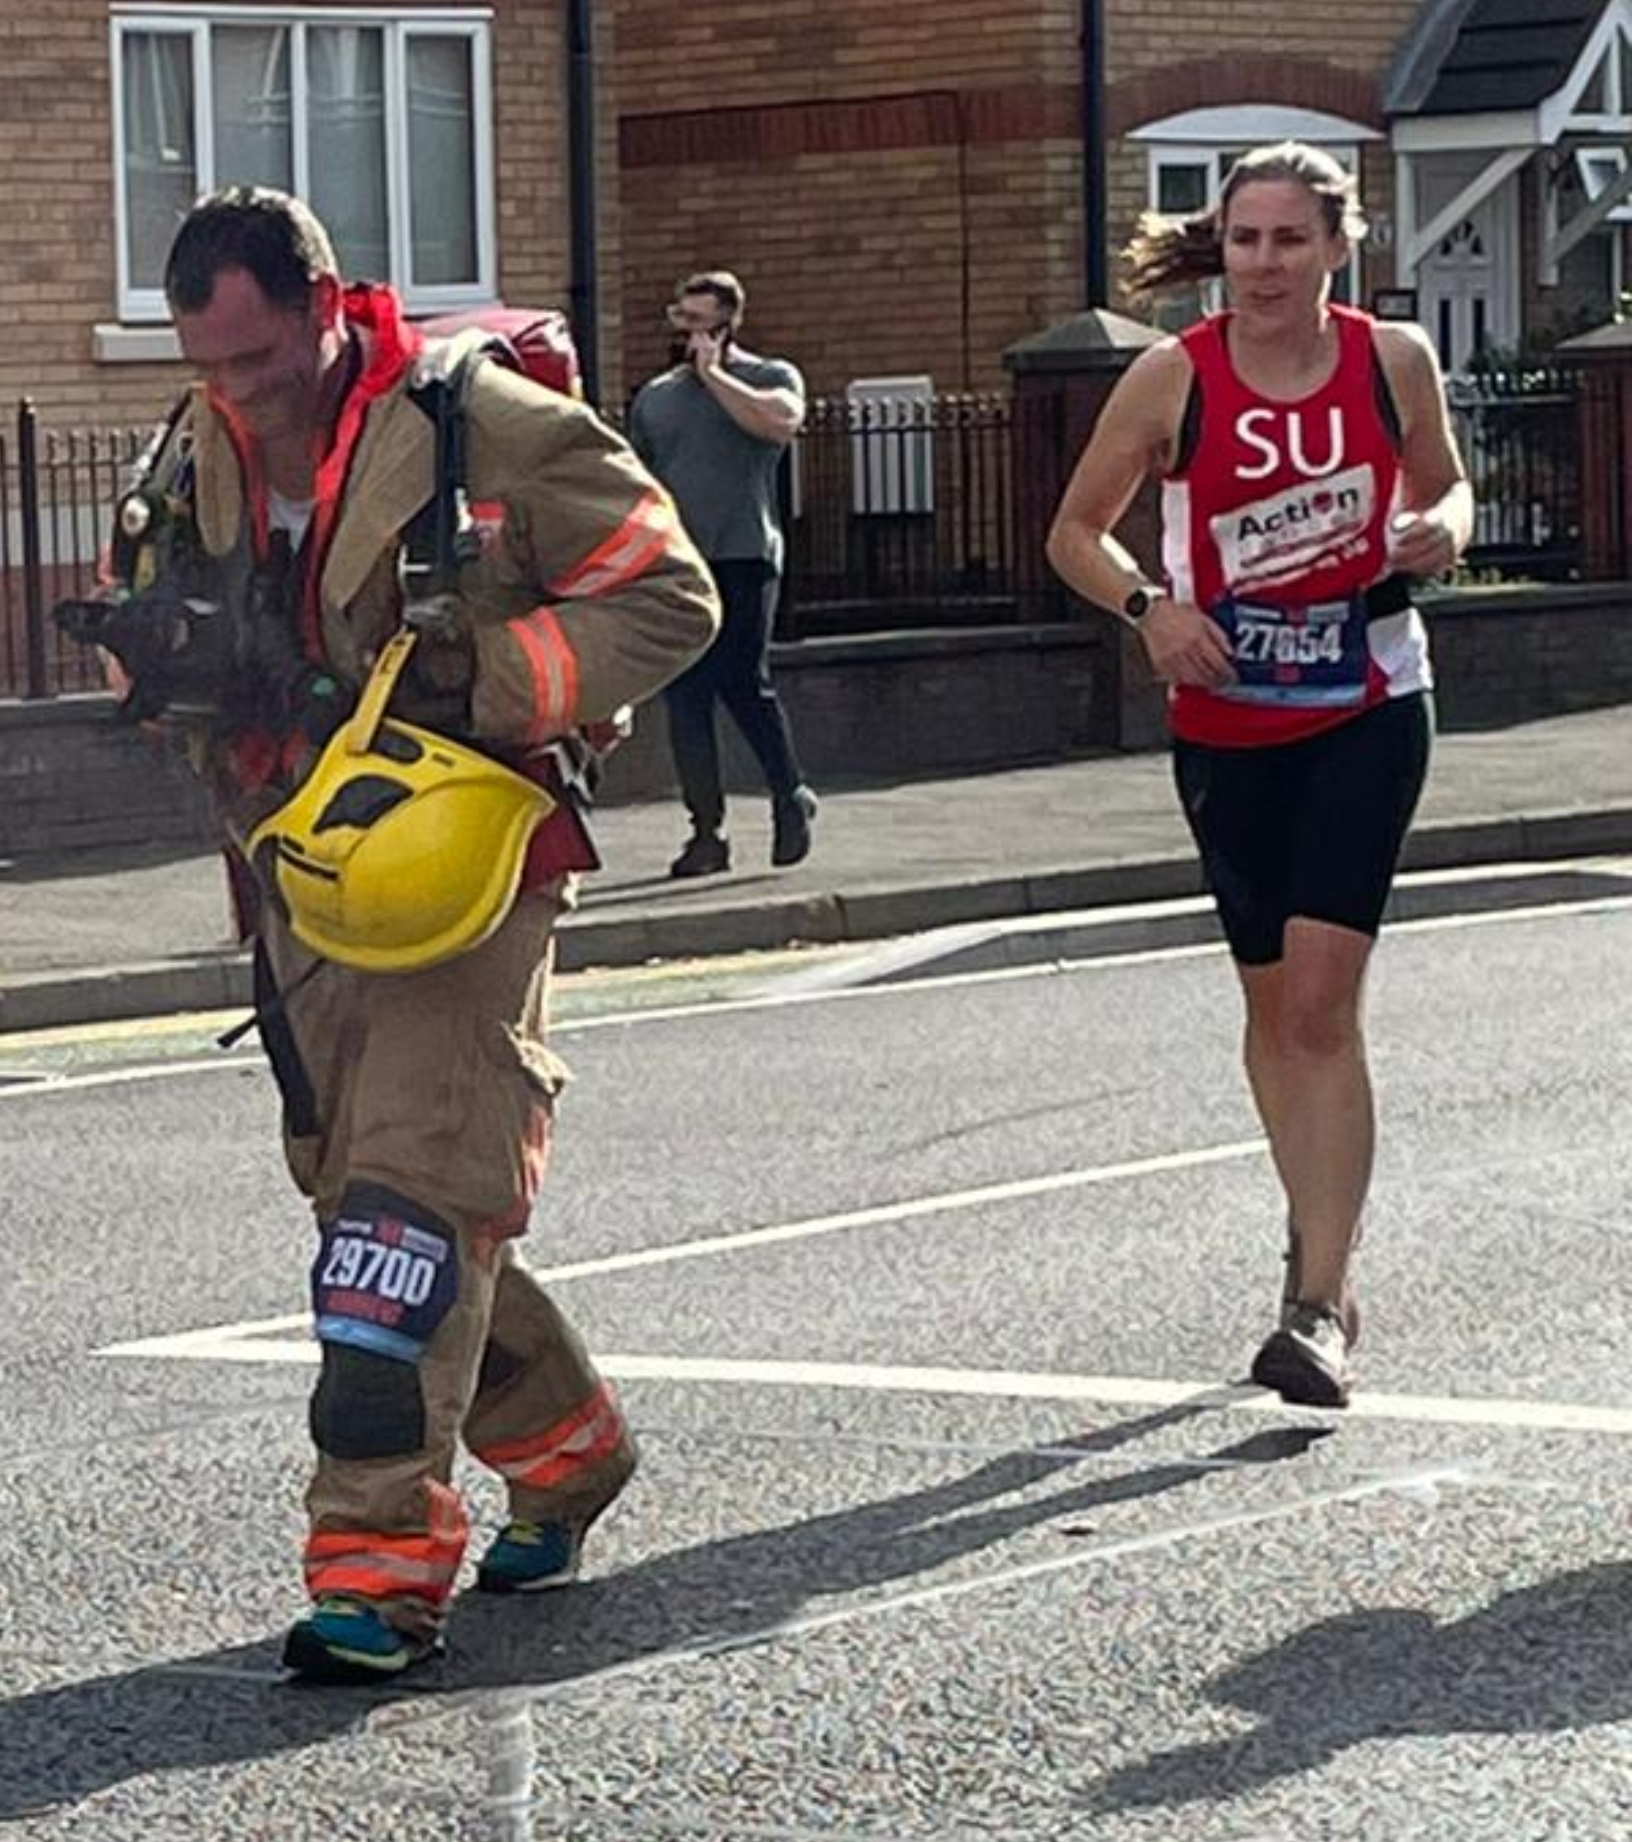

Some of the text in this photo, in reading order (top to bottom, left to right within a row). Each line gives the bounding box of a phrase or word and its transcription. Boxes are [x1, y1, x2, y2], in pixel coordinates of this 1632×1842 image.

[1234, 407, 1344, 479] SU
[1237, 488, 1359, 542] Action
[322, 1237, 435, 1305] 29700
